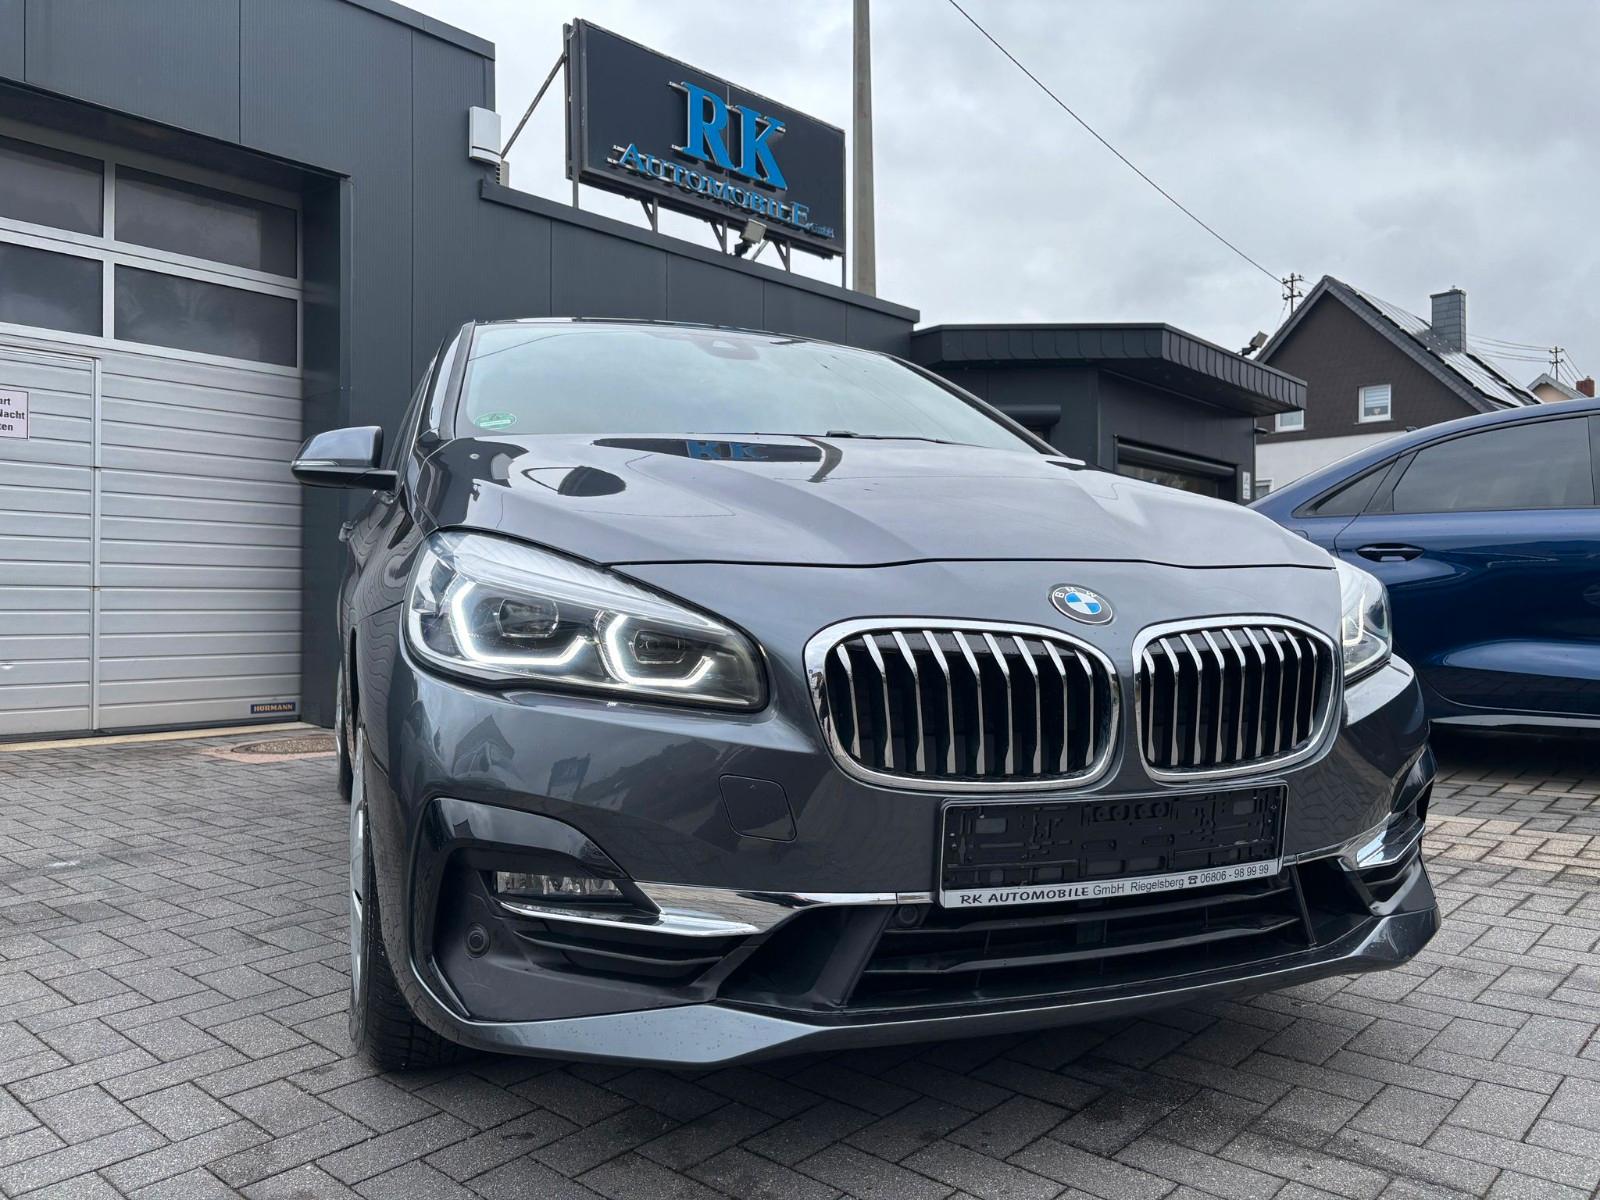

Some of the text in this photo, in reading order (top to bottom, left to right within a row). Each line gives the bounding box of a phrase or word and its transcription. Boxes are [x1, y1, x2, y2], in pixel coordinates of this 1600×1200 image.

[668, 82, 787, 190] RK
[607, 143, 809, 226] AUTOMOBILE
[0, 423, 13, 431] en
[960, 894, 982, 905] RK
[988, 887, 1089, 903] AUTOMOBILE
[1093, 884, 1124, 896] GmbH
[1131, 878, 1184, 892] Riegelsberg
[1200, 871, 1227, 884] 06806
[1234, 867, 1245, 878] 98
[1247, 865, 1257, 876] 99
[1259, 864, 1269, 875] 99
